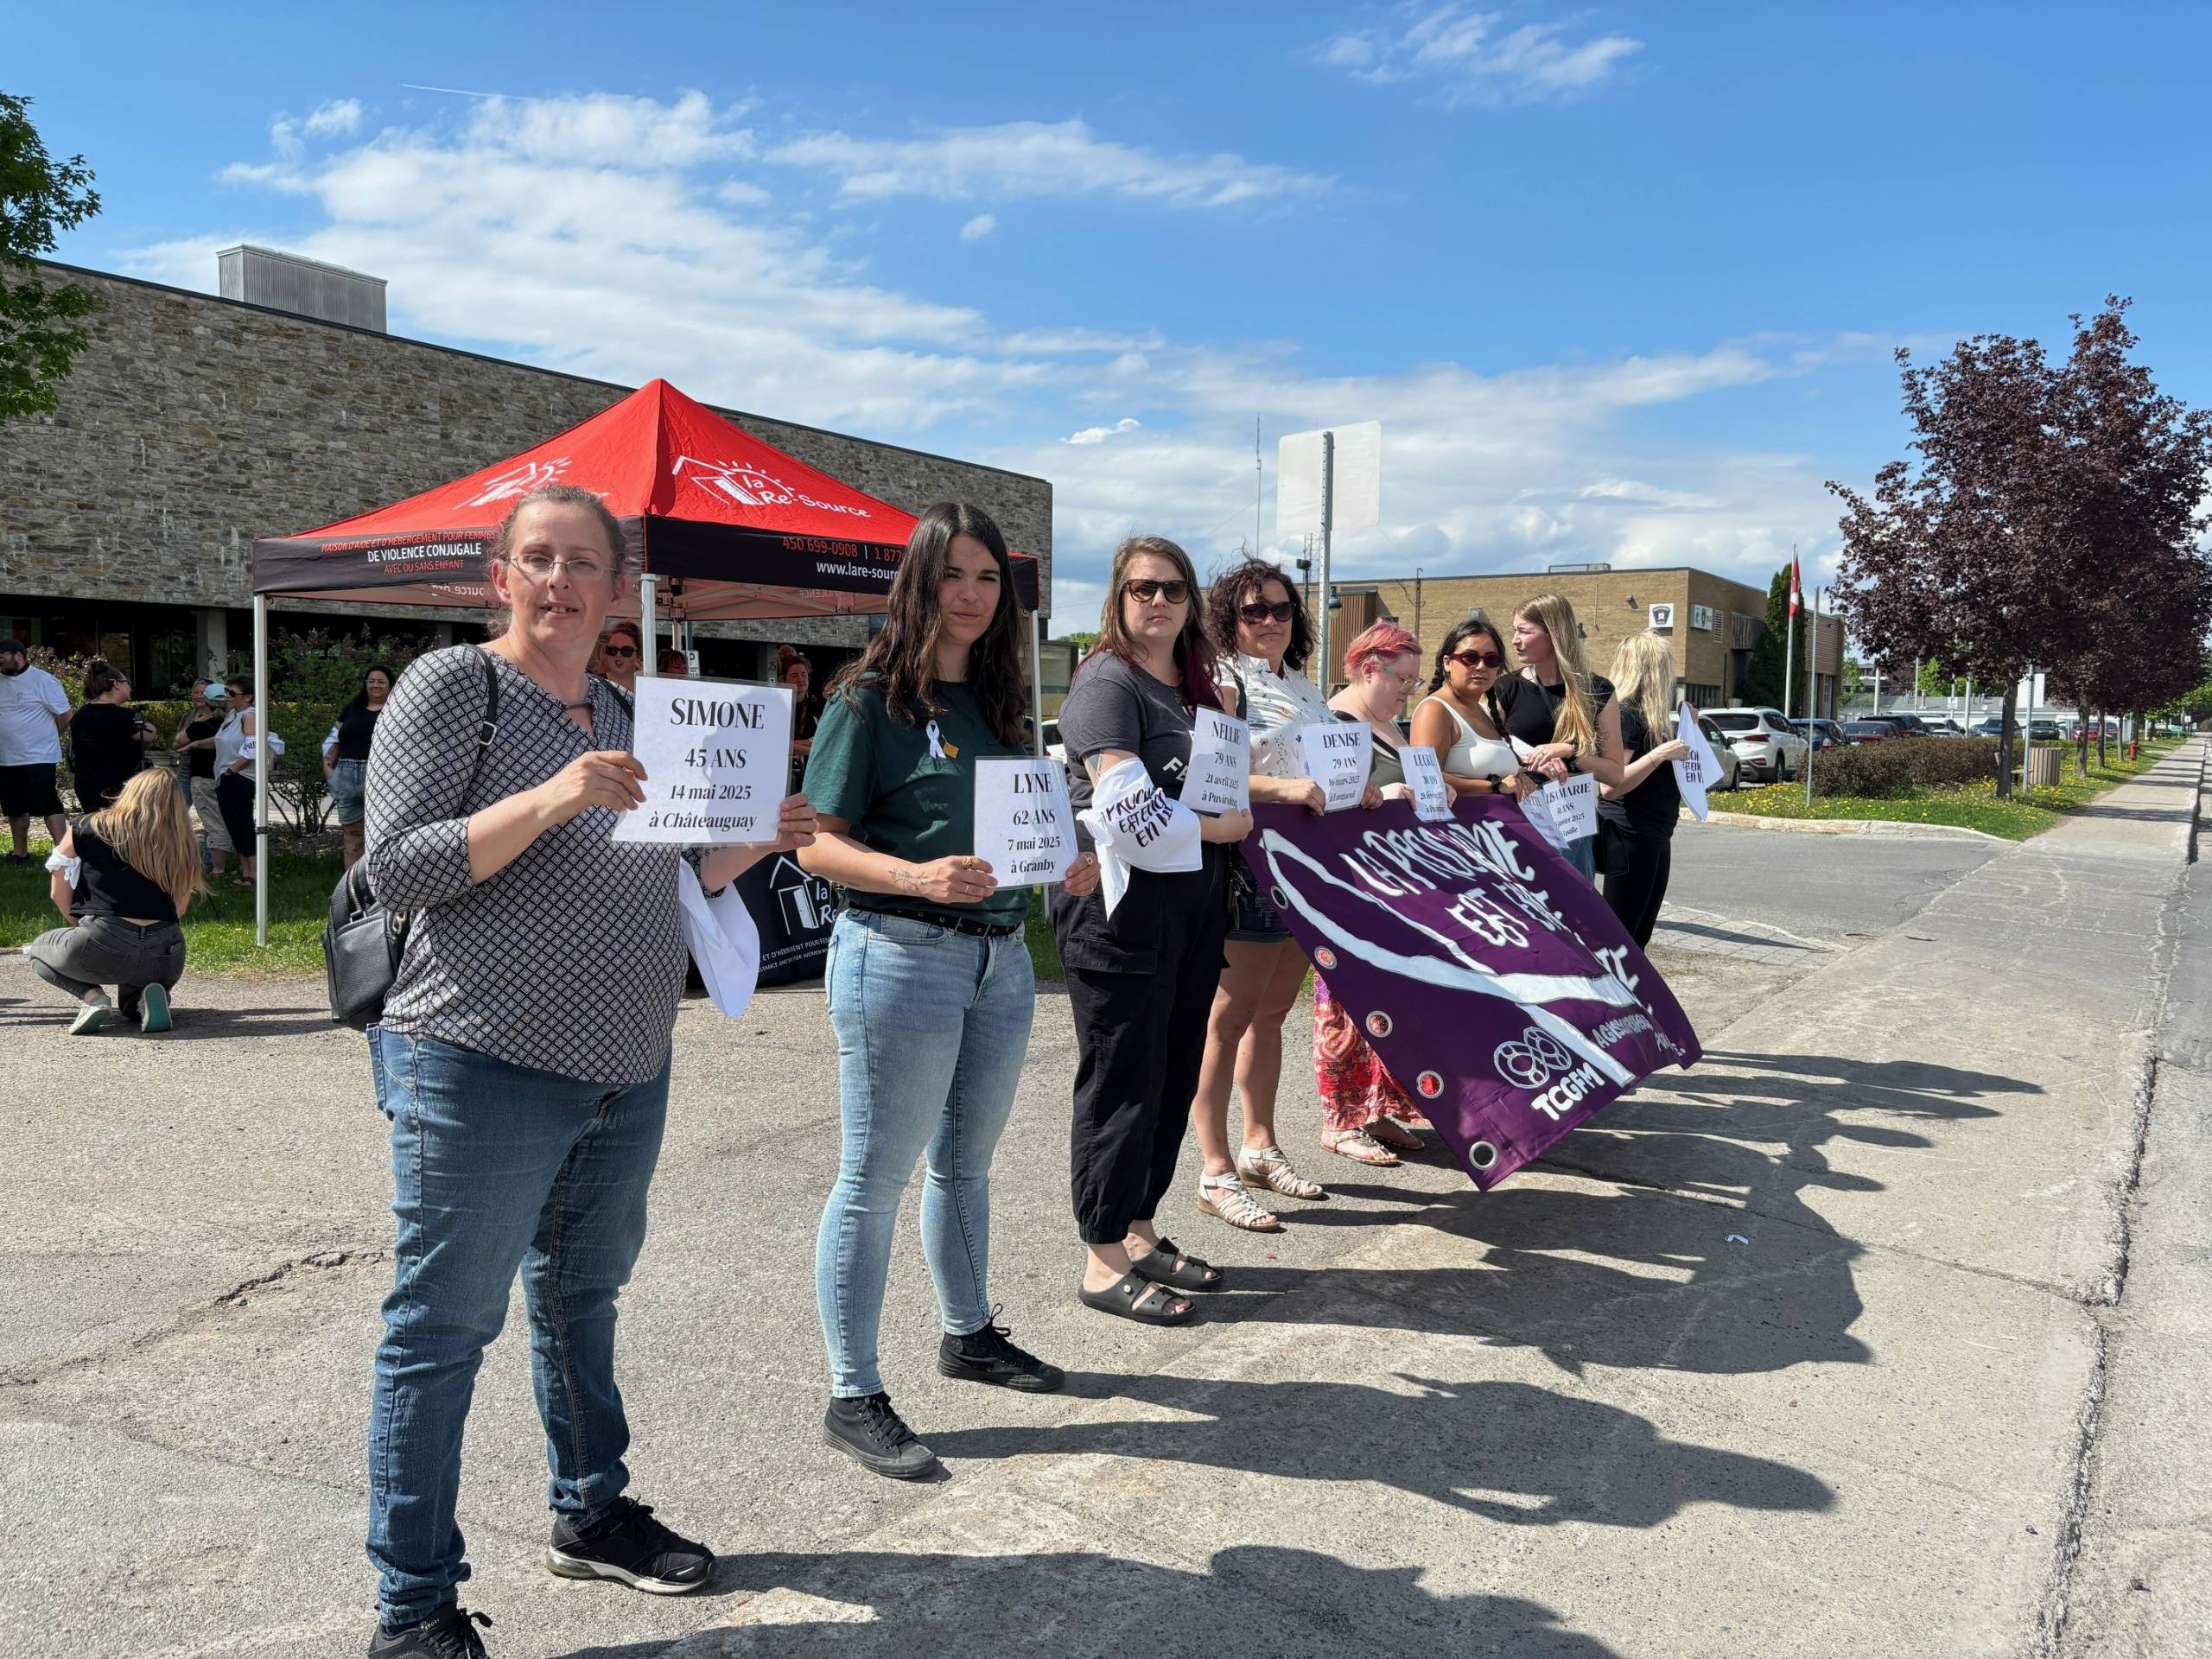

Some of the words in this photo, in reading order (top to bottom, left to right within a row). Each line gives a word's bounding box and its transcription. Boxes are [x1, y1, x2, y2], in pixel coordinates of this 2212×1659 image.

[743, 475, 765, 488] la
[759, 491, 871, 518] Re-Source
[321, 542, 346, 552] MAISON
[372, 538, 380, 547] ET
[443, 531, 463, 540] POUR
[783, 537, 804, 550] 450
[807, 541, 858, 557] 699-0908
[367, 550, 380, 563] DE
[381, 546, 424, 561] VIOLENCE
[427, 543, 481, 556] CONJUGALE
[385, 563, 401, 574] AVEC
[404, 563, 413, 572] OU
[415, 562, 433, 571] SANS
[435, 560, 464, 570] ENFANT
[670, 697, 765, 729] SIMONE
[1212, 721, 1241, 745] NELLIE
[1323, 733, 1360, 748] DENISE
[685, 748, 707, 767] 45
[711, 749, 747, 768] ANS
[1215, 752, 1224, 765] 79
[1225, 754, 1236, 768] ANS
[1332, 759, 1341, 769] 79
[1344, 757, 1357, 767] ANS
[1014, 773, 1052, 793] LYNE
[1205, 773, 1213, 783] 21
[1329, 779, 1334, 787] 16
[671, 785, 684, 799] 14
[689, 785, 715, 799] mai
[719, 785, 751, 799] 2025
[1201, 790, 1207, 801] à
[1559, 782, 1591, 798] MARIE
[649, 811, 658, 828] à
[663, 812, 757, 831] Châteauguay
[1013, 810, 1028, 825] 62
[1032, 809, 1056, 824] ANS
[1572, 813, 1585, 822] 2025
[1007, 839, 1014, 850] 7
[1016, 837, 1035, 850] mai
[1038, 836, 1060, 849] 2025
[1135, 822, 1160, 848] EN
[1011, 860, 1016, 873] à
[1020, 858, 1056, 874] Granby
[1338, 848, 1422, 897] LA
[817, 881, 828, 900] la
[1445, 887, 1529, 948] EST
[1531, 1062, 1605, 1121] TCGFM
